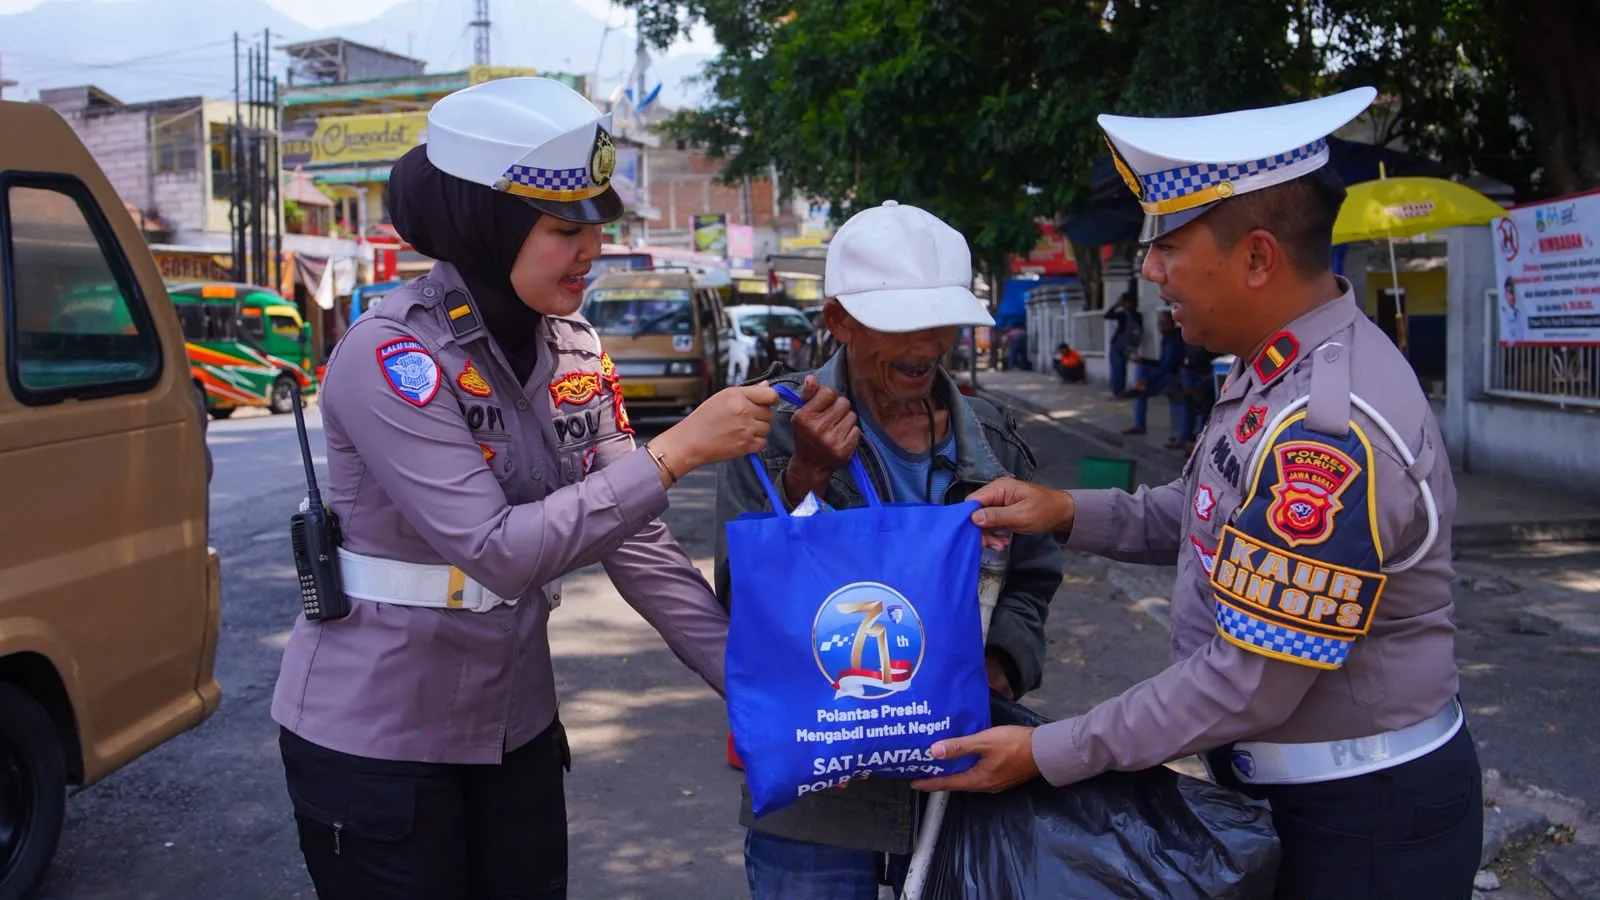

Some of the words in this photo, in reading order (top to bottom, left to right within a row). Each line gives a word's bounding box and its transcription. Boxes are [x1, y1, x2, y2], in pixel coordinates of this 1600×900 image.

[381, 342, 403, 356] LALU
[1286, 450, 1347, 473] POLRES
[1295, 457, 1336, 473] GARUT
[1288, 471, 1310, 481] JAWA
[1311, 474, 1335, 490] BARAT
[1229, 536, 1363, 601] KAUR
[1216, 559, 1275, 608] BIN
[1278, 588, 1363, 628] OPS
[896, 634, 909, 648] th
[816, 708, 879, 723] Polantas
[880, 700, 932, 719] Presisi,
[796, 725, 864, 744] Mengabdi
[866, 723, 906, 738] untuk
[908, 716, 951, 735] Negeri
[813, 755, 854, 775] SAT
[857, 748, 935, 767] LANTAS
